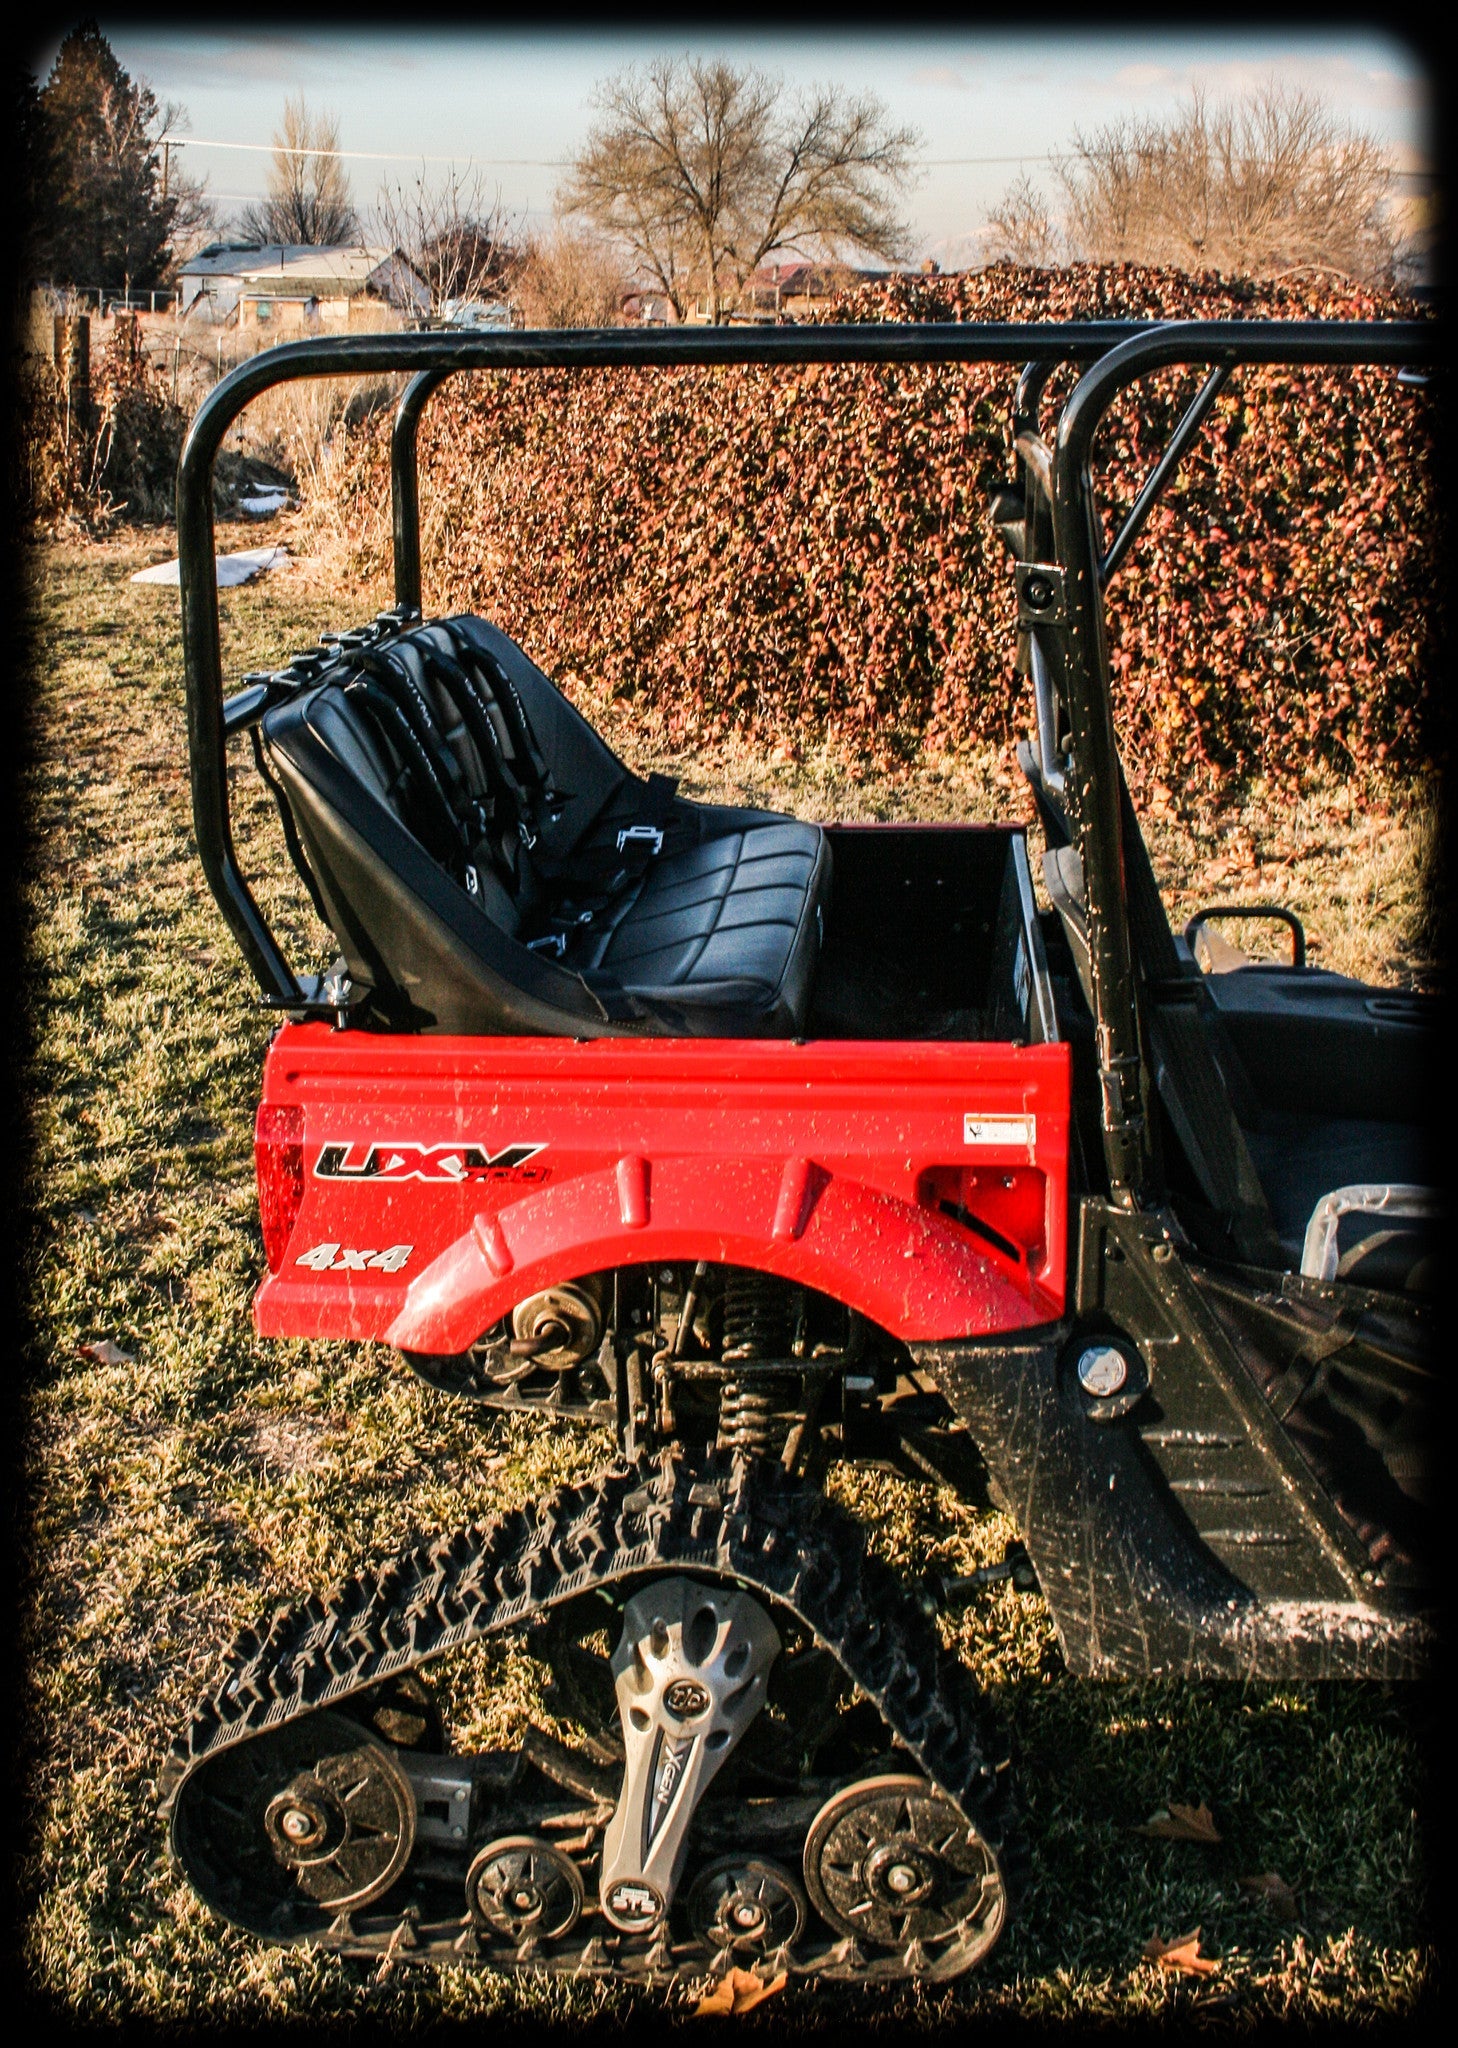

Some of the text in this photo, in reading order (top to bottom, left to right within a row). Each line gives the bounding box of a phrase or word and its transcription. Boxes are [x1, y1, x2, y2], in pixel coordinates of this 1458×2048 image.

[314, 1142, 550, 1182] UXV
[295, 1243, 414, 1272] 4x4
[658, 1745, 683, 1803] XGEN
